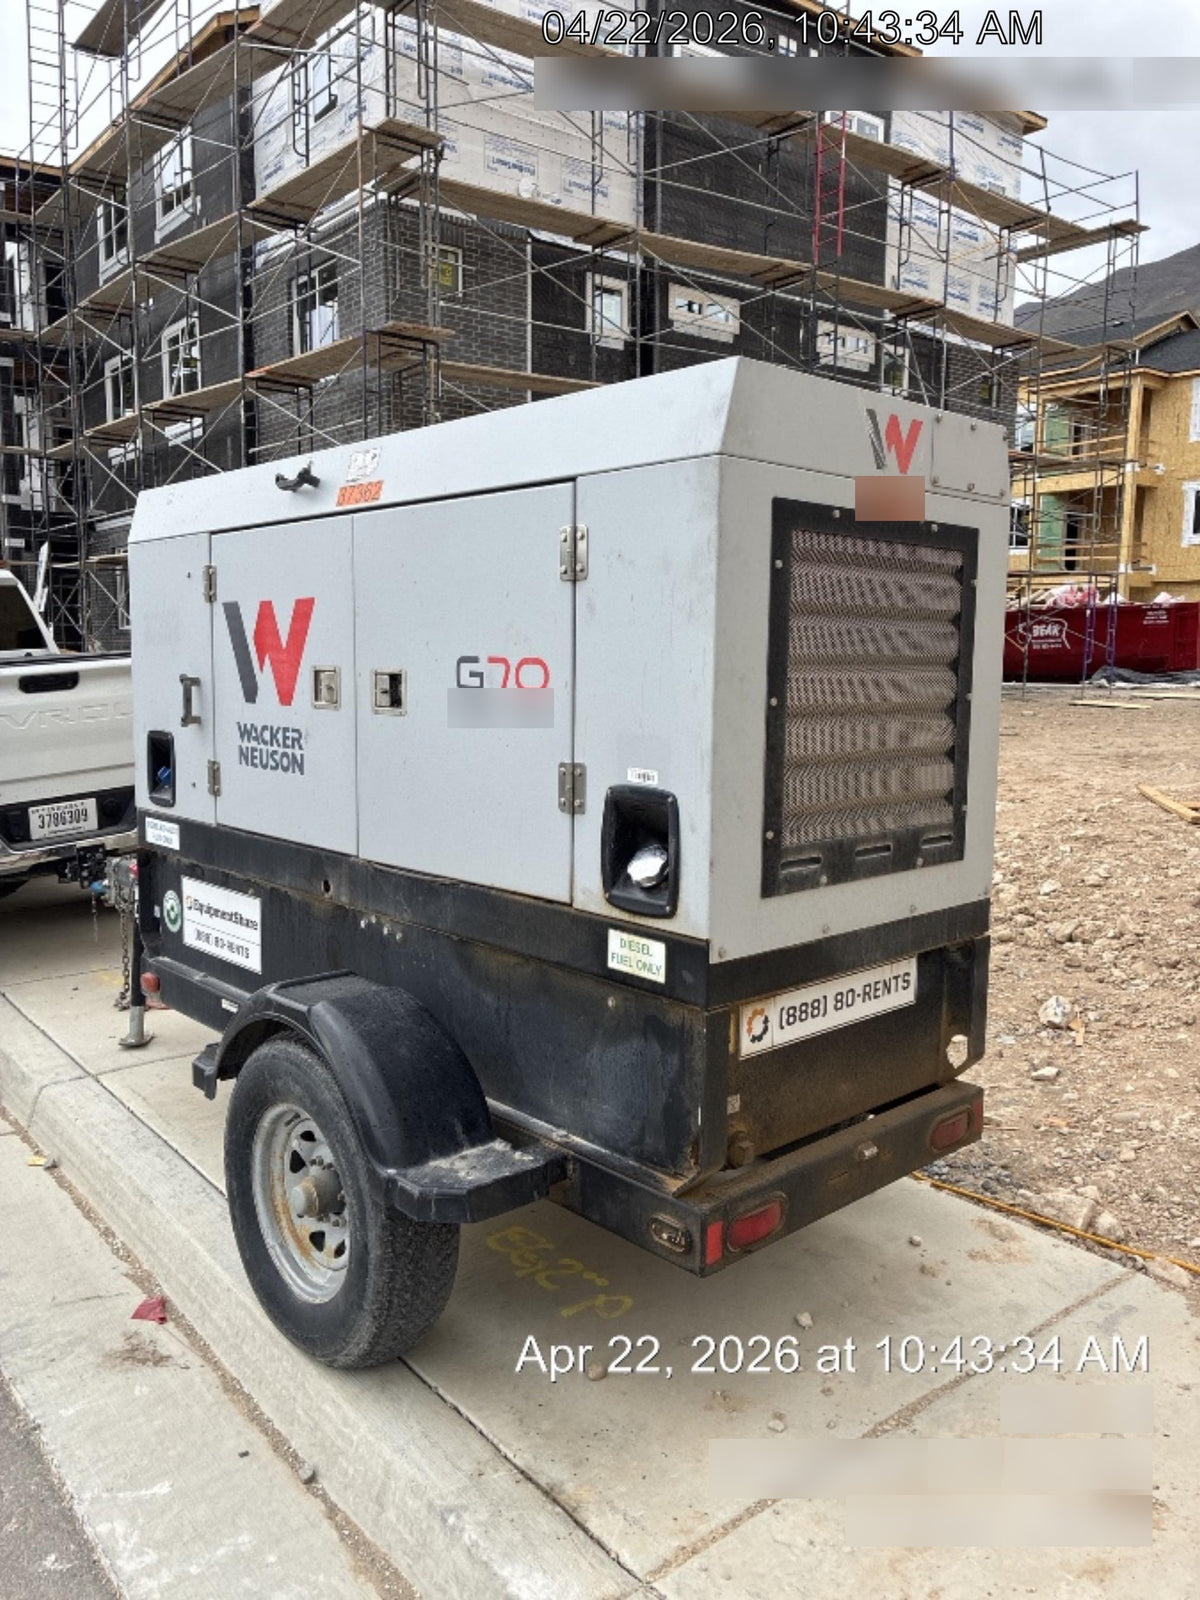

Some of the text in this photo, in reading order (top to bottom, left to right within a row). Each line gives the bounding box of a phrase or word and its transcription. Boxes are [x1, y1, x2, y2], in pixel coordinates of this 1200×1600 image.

[236, 721, 304, 751] WACKER
[238, 745, 305, 776] NEUSON
[38, 808, 88, 829] 3786309
[620, 937, 653, 957] DIESEL
[611, 951, 663, 976] FUEL ONLY
[779, 972, 912, 1031] (888) 80-RENTS
